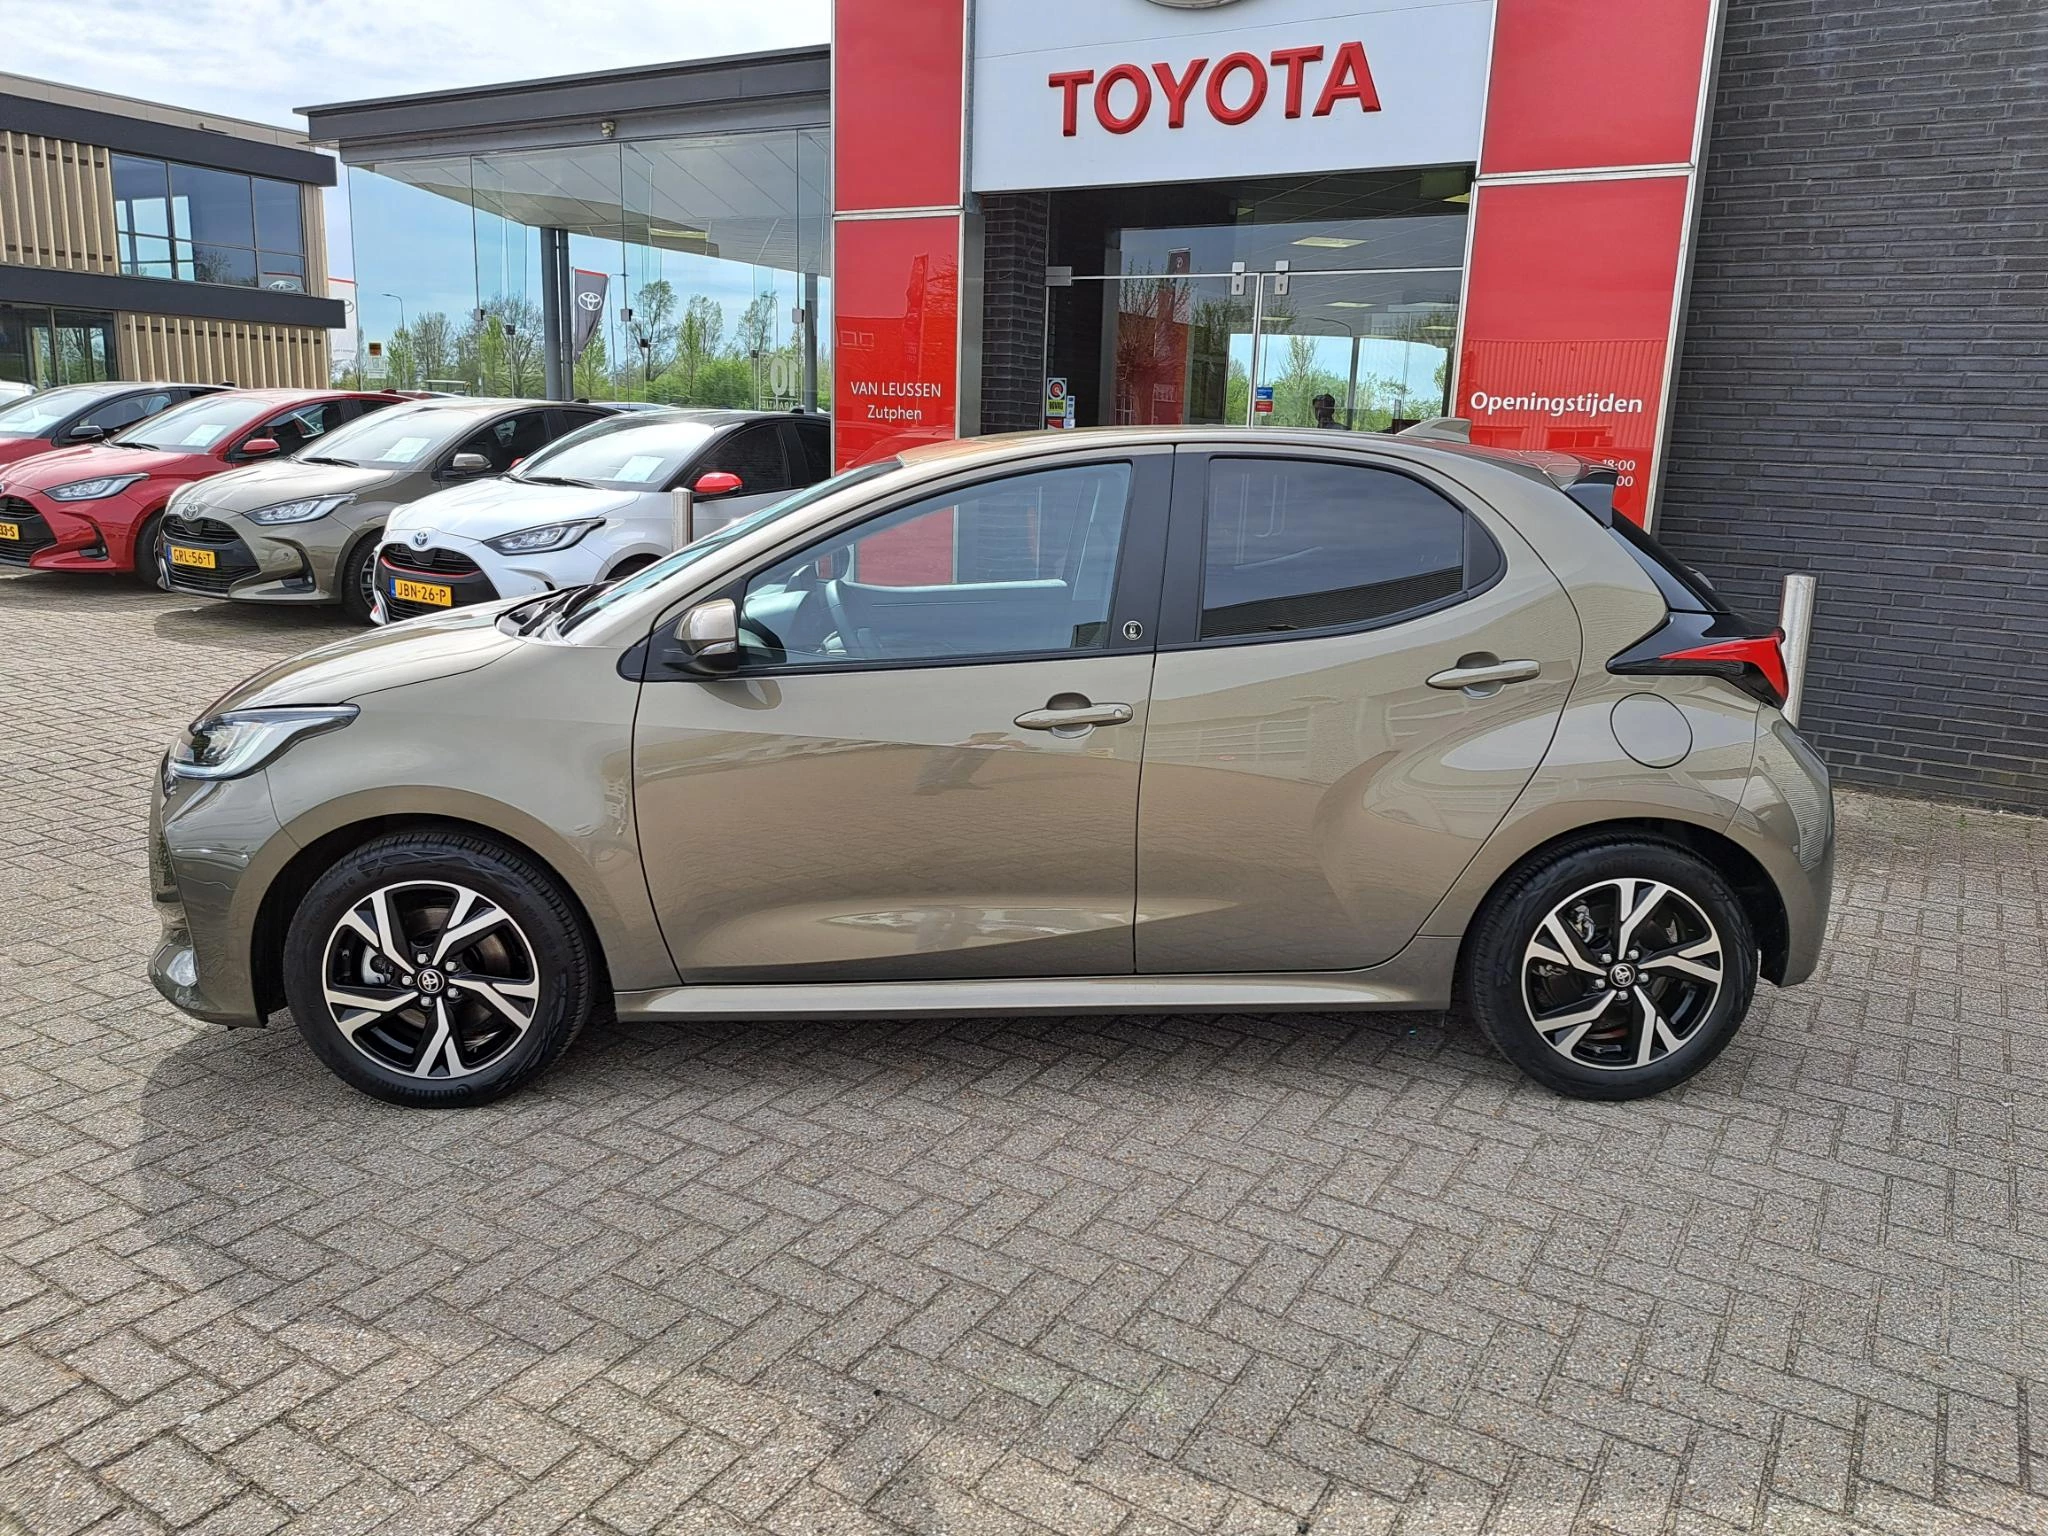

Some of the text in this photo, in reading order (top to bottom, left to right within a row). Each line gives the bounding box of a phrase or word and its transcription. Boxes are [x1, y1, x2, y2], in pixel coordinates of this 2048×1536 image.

[1048, 41, 1382, 137] TOYOTA
[850, 381, 941, 398] VAN LEUSSEN
[867, 404, 922, 423] Zutphen
[1470, 391, 1643, 418] Openingstijden
[173, 548, 212, 566] GRL-56-T
[398, 582, 447, 603] JBN-26-P
